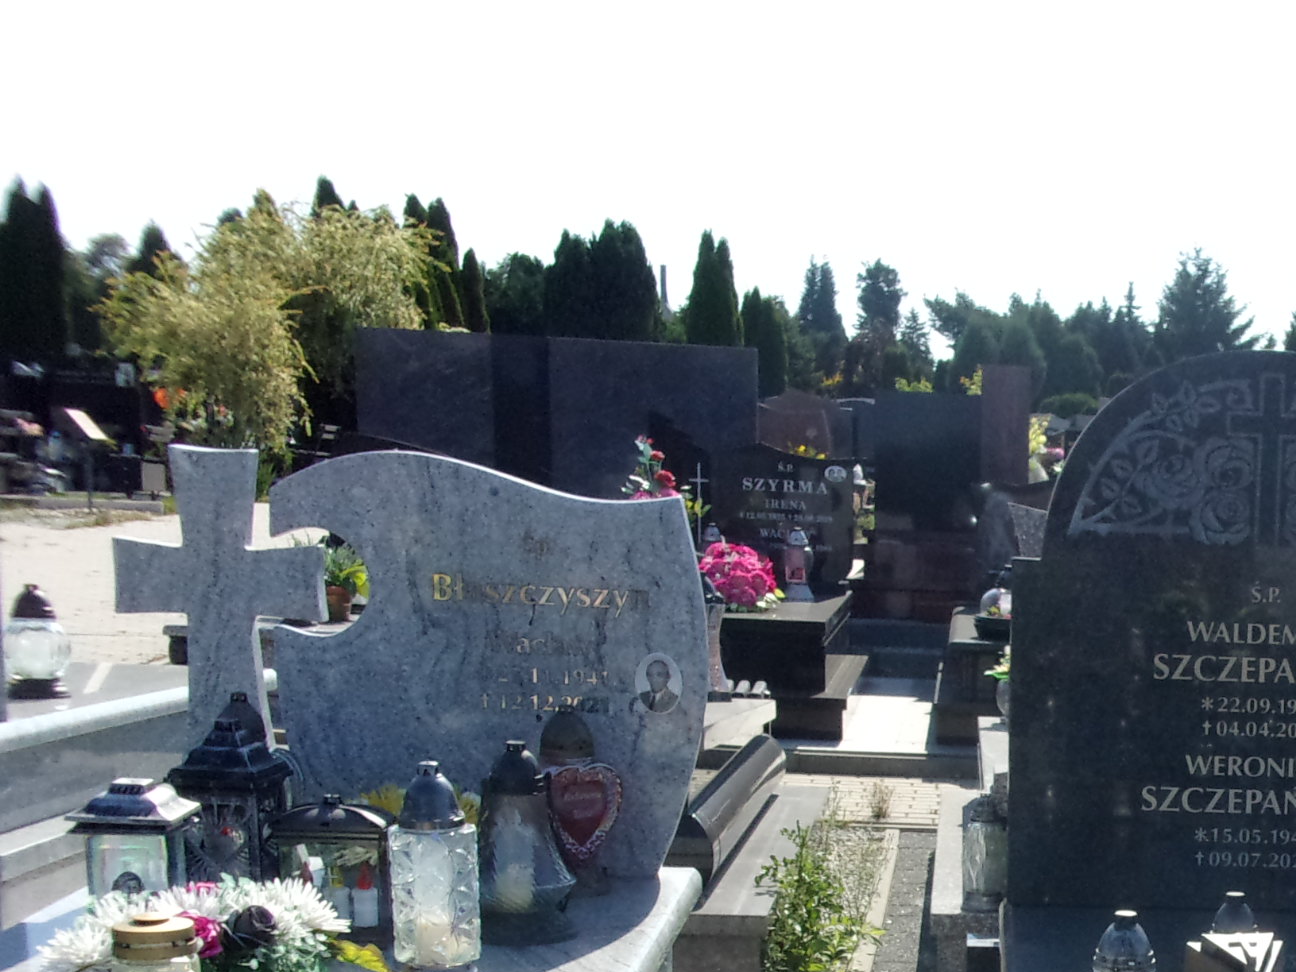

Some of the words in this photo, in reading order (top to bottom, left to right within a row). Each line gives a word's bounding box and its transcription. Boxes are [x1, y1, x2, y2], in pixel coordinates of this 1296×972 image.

[742, 477, 828, 495] SZYRMA
[765, 498, 806, 510] IRENA
[432, 572, 650, 618] Błszczyszyn
[1250, 581, 1282, 603] Ś.P.
